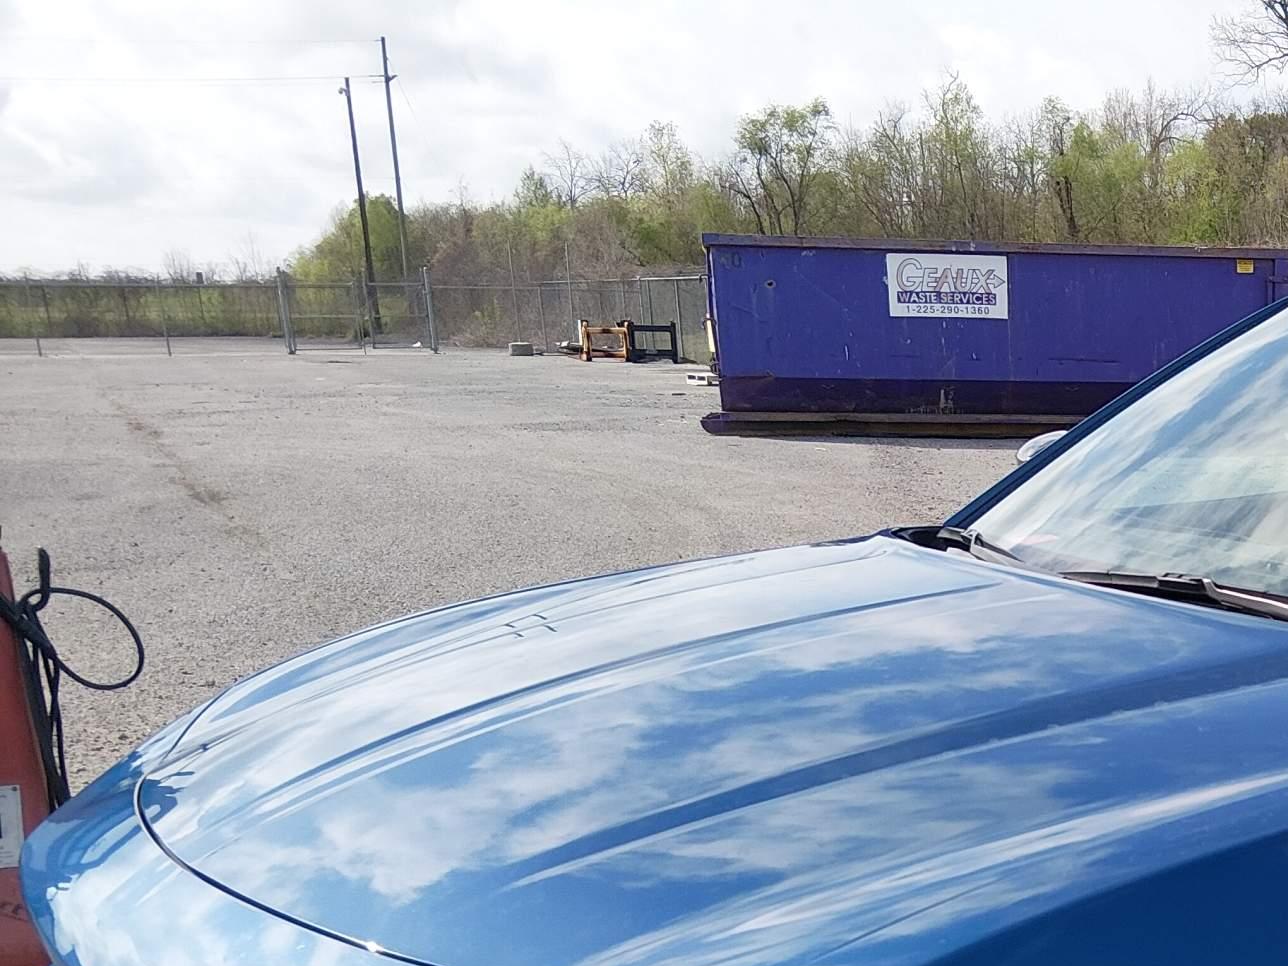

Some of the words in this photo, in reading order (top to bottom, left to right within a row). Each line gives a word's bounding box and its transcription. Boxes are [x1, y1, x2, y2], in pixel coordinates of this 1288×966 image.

[896, 257, 997, 293] GEAUX
[898, 292, 937, 303] WASTE
[940, 292, 996, 305] SERVICES
[905, 305, 990, 315] 1-225-290-1360
